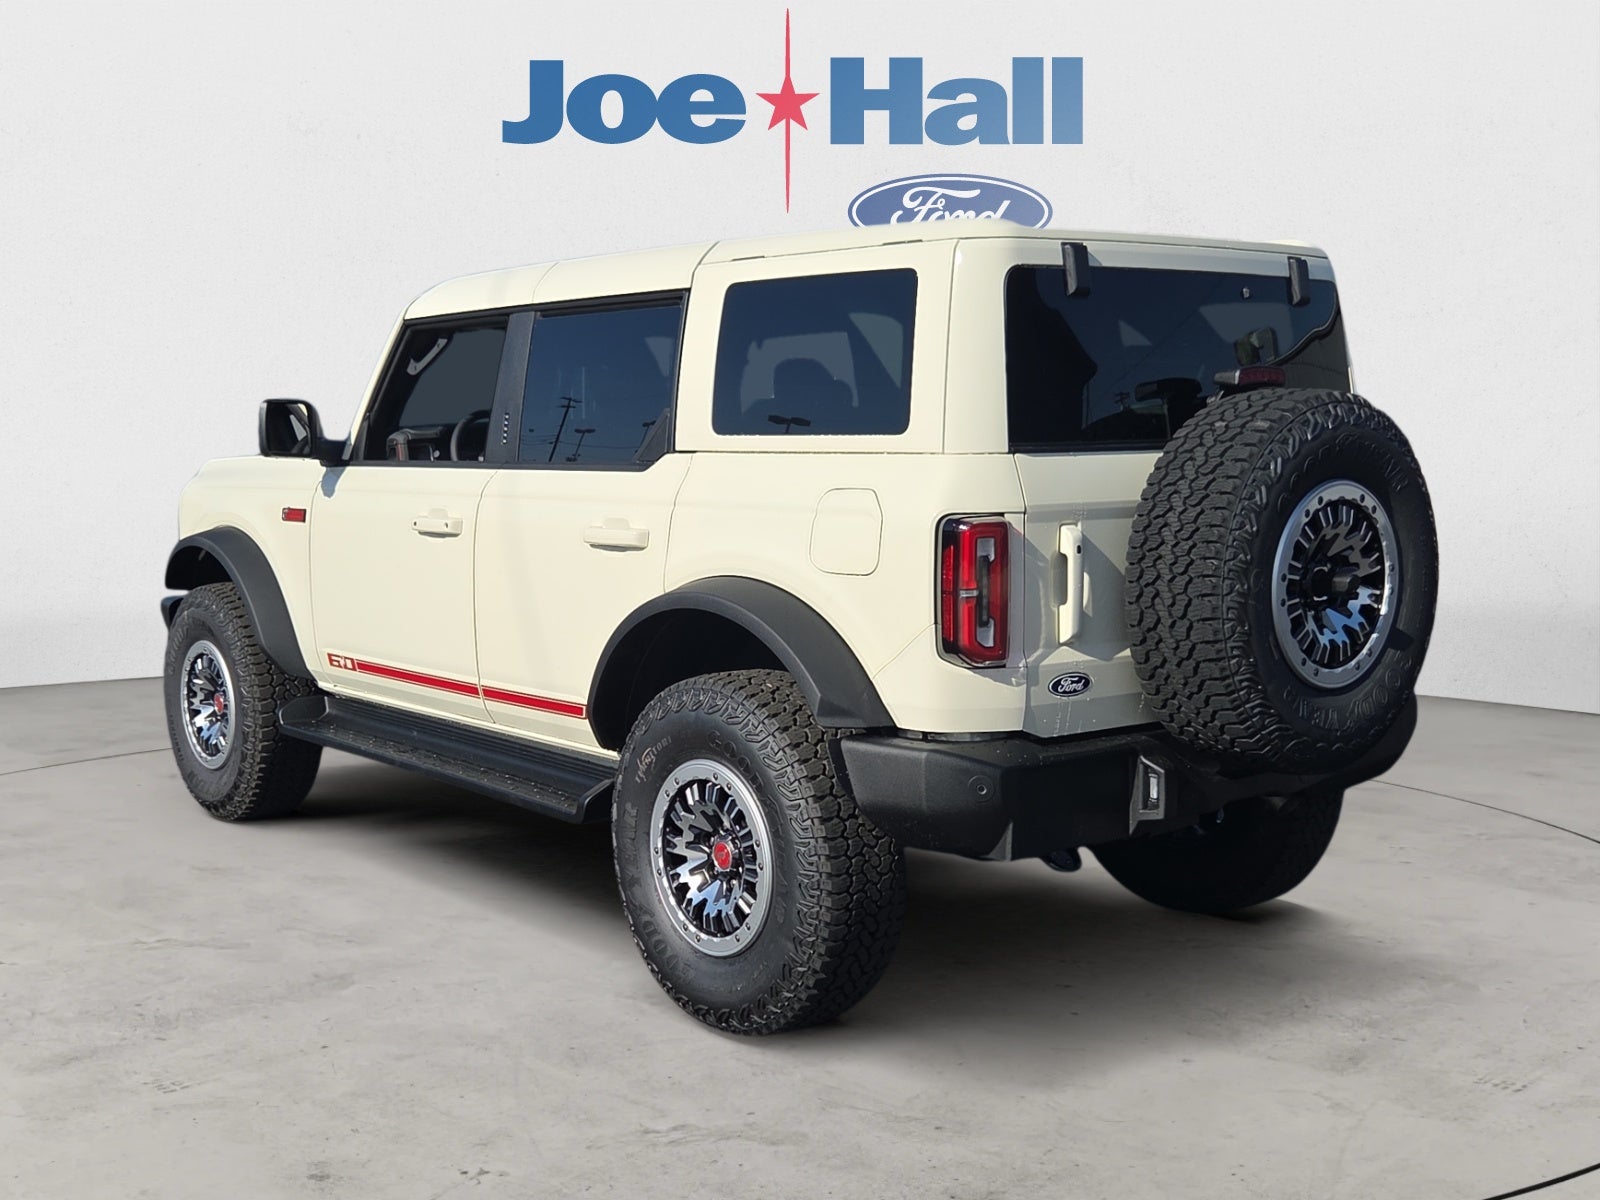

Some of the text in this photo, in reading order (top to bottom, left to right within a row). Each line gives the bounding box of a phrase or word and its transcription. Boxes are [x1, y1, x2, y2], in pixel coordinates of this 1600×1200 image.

[502, 57, 1083, 145] Joe Hall
[326, 652, 357, 672] 60
[1057, 677, 1085, 692] Ford
